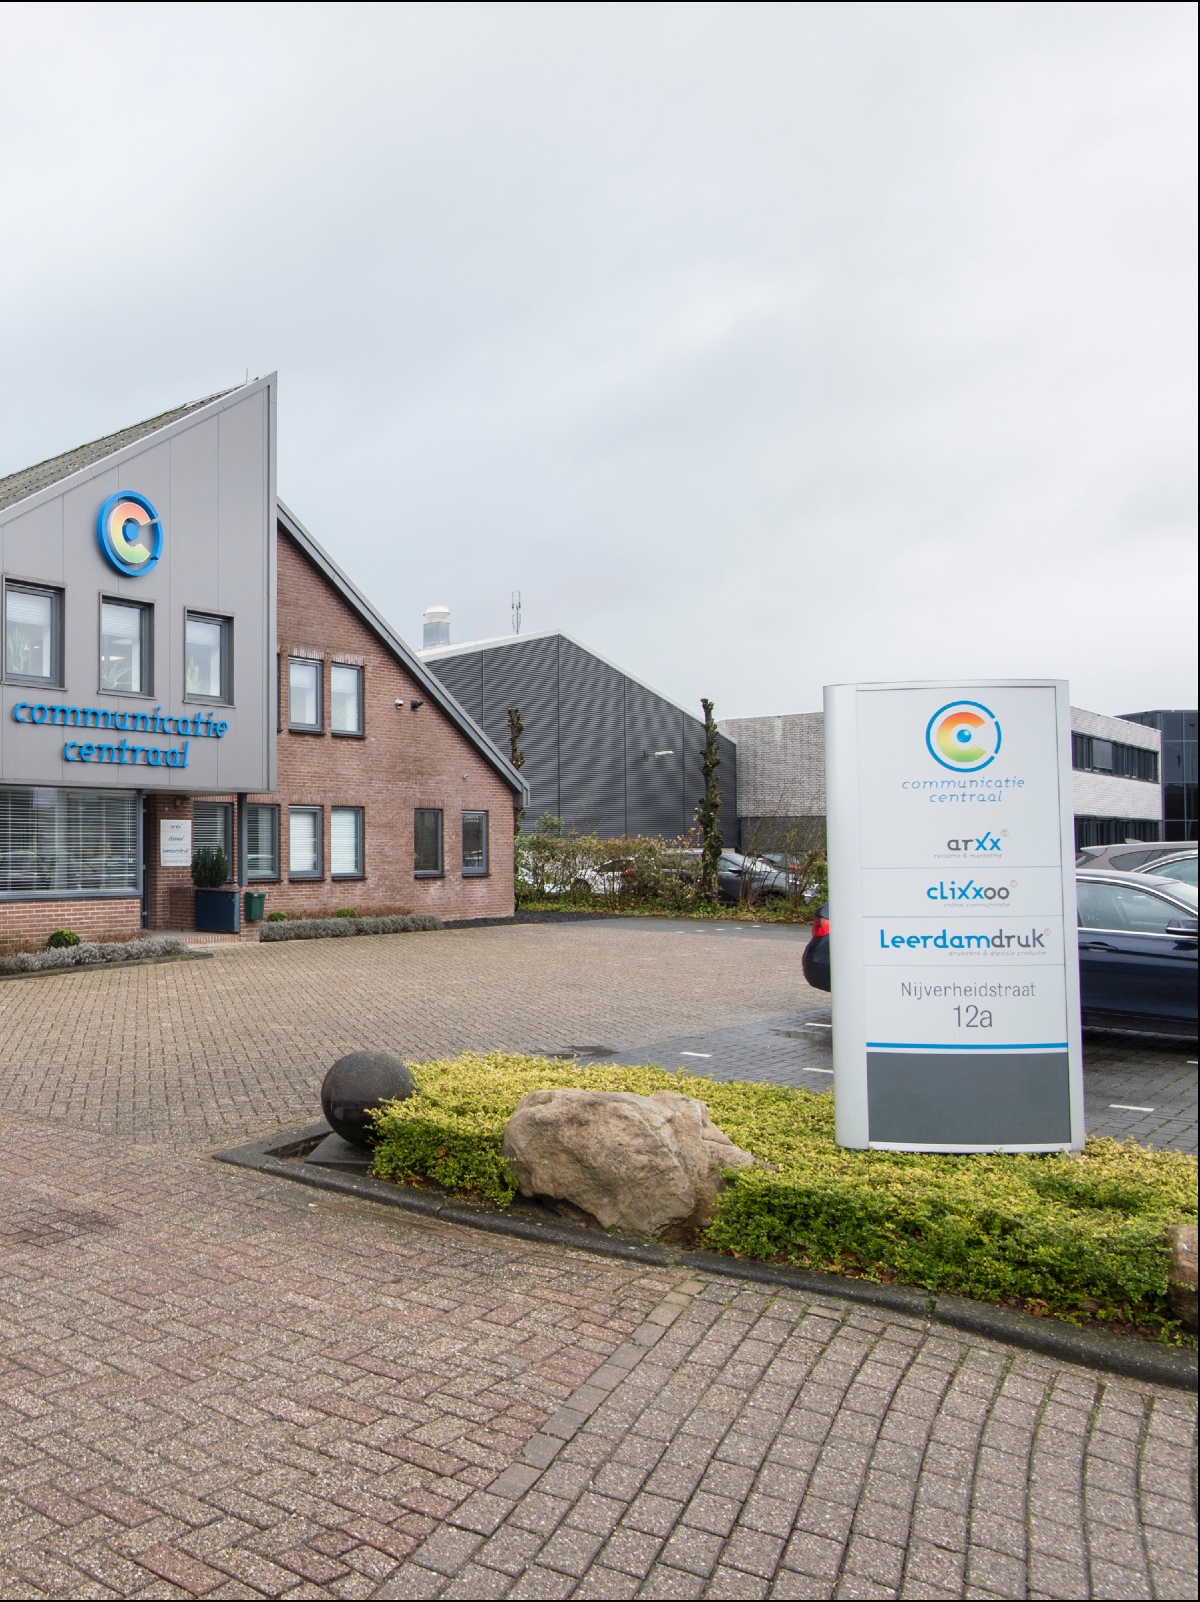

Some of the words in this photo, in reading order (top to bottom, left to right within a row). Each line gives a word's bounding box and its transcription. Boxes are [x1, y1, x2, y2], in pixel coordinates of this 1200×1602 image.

[13, 702, 229, 738] communicatie
[63, 738, 190, 768] centraal
[901, 776, 1025, 790] communicatie
[929, 790, 1003, 803] centraal
[947, 831, 1002, 851] arxx
[901, 981, 1037, 1000] Nijverheidstraat
[953, 1004, 993, 1028] 12a
